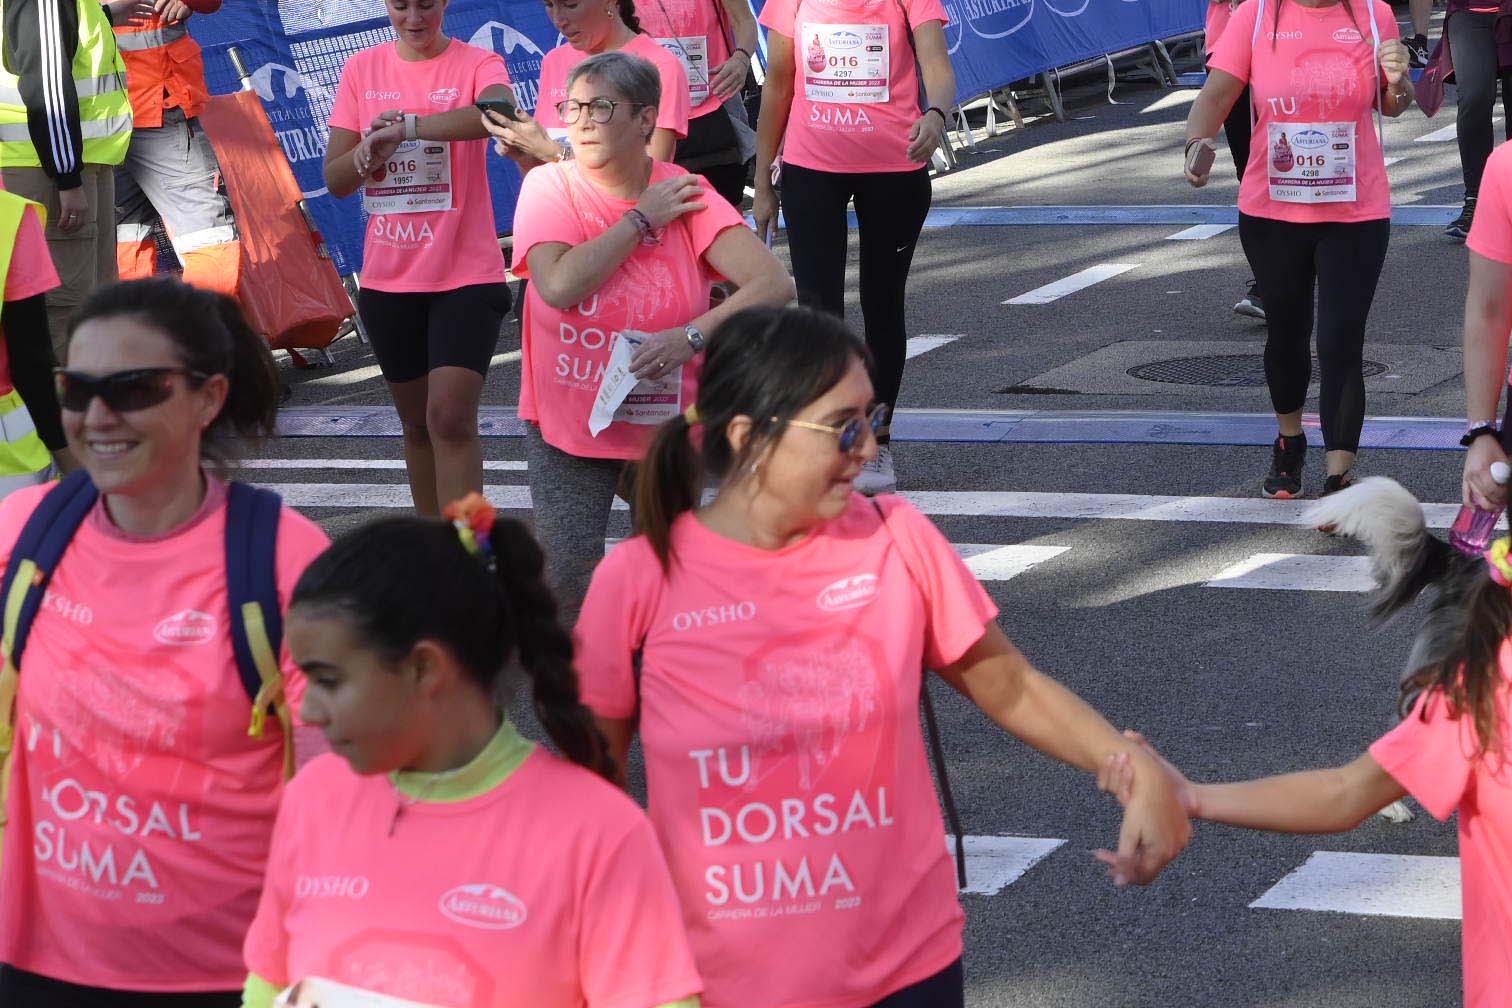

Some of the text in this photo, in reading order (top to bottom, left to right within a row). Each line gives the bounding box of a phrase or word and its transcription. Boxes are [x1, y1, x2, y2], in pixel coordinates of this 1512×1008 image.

[1267, 30, 1303, 41] OYSHO
[828, 56, 858, 67] 016
[833, 70, 852, 78] 4297
[810, 104, 871, 125] SUMA
[1267, 97, 1296, 117] TU
[388, 159, 416, 174] 016
[1296, 155, 1325, 166] 016
[1301, 169, 1319, 177] 4298
[374, 216, 434, 242] SUMA
[635, 409, 670, 418] Santander
[43, 592, 93, 625] YSHO
[673, 601, 756, 632] OYSHO
[689, 745, 750, 789] TU
[700, 787, 894, 846] DORSAL
[35, 820, 158, 888] SUMA
[295, 875, 370, 899] OYSHO
[705, 853, 855, 906] SUMA
